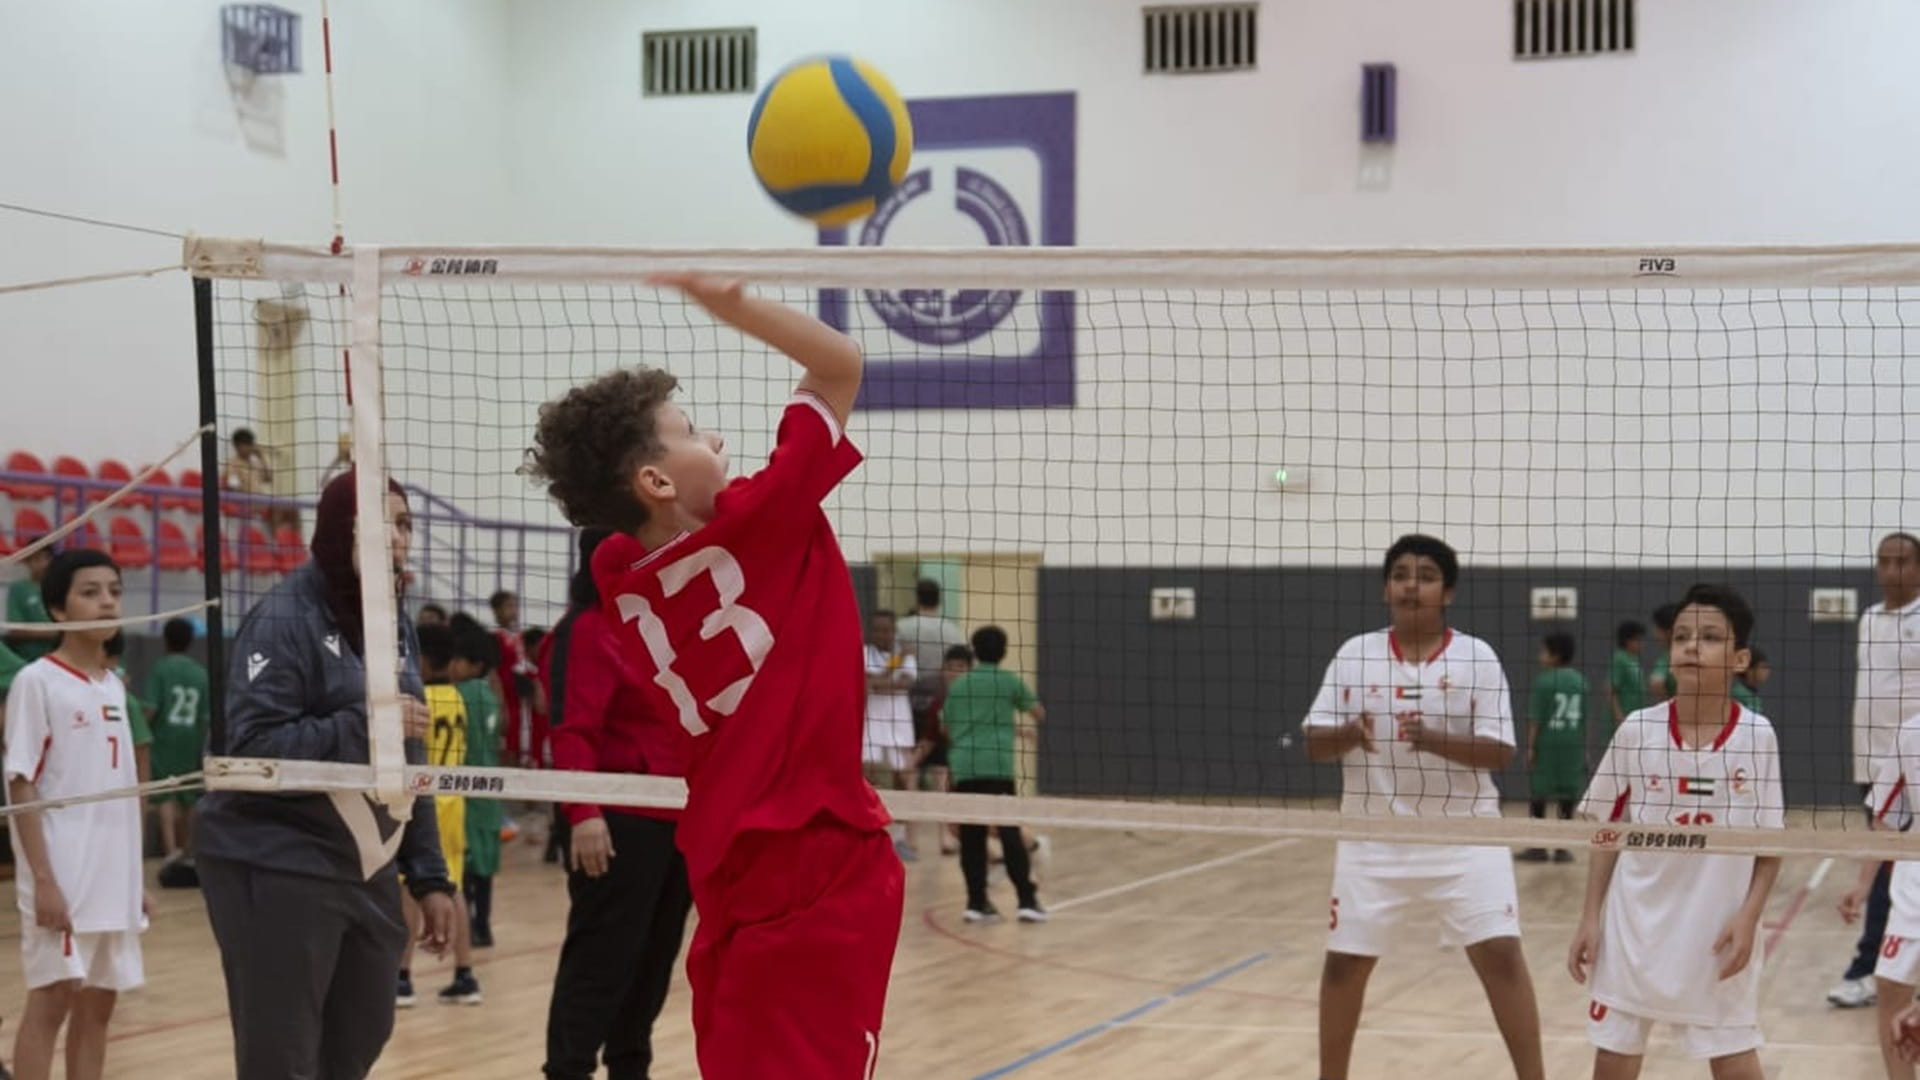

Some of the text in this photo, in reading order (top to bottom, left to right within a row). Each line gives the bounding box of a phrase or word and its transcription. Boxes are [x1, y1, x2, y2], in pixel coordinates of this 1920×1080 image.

[615, 545, 775, 737] 13
[169, 685, 200, 727] 23
[1549, 693, 1581, 729] 24
[107, 736, 118, 769] 7
